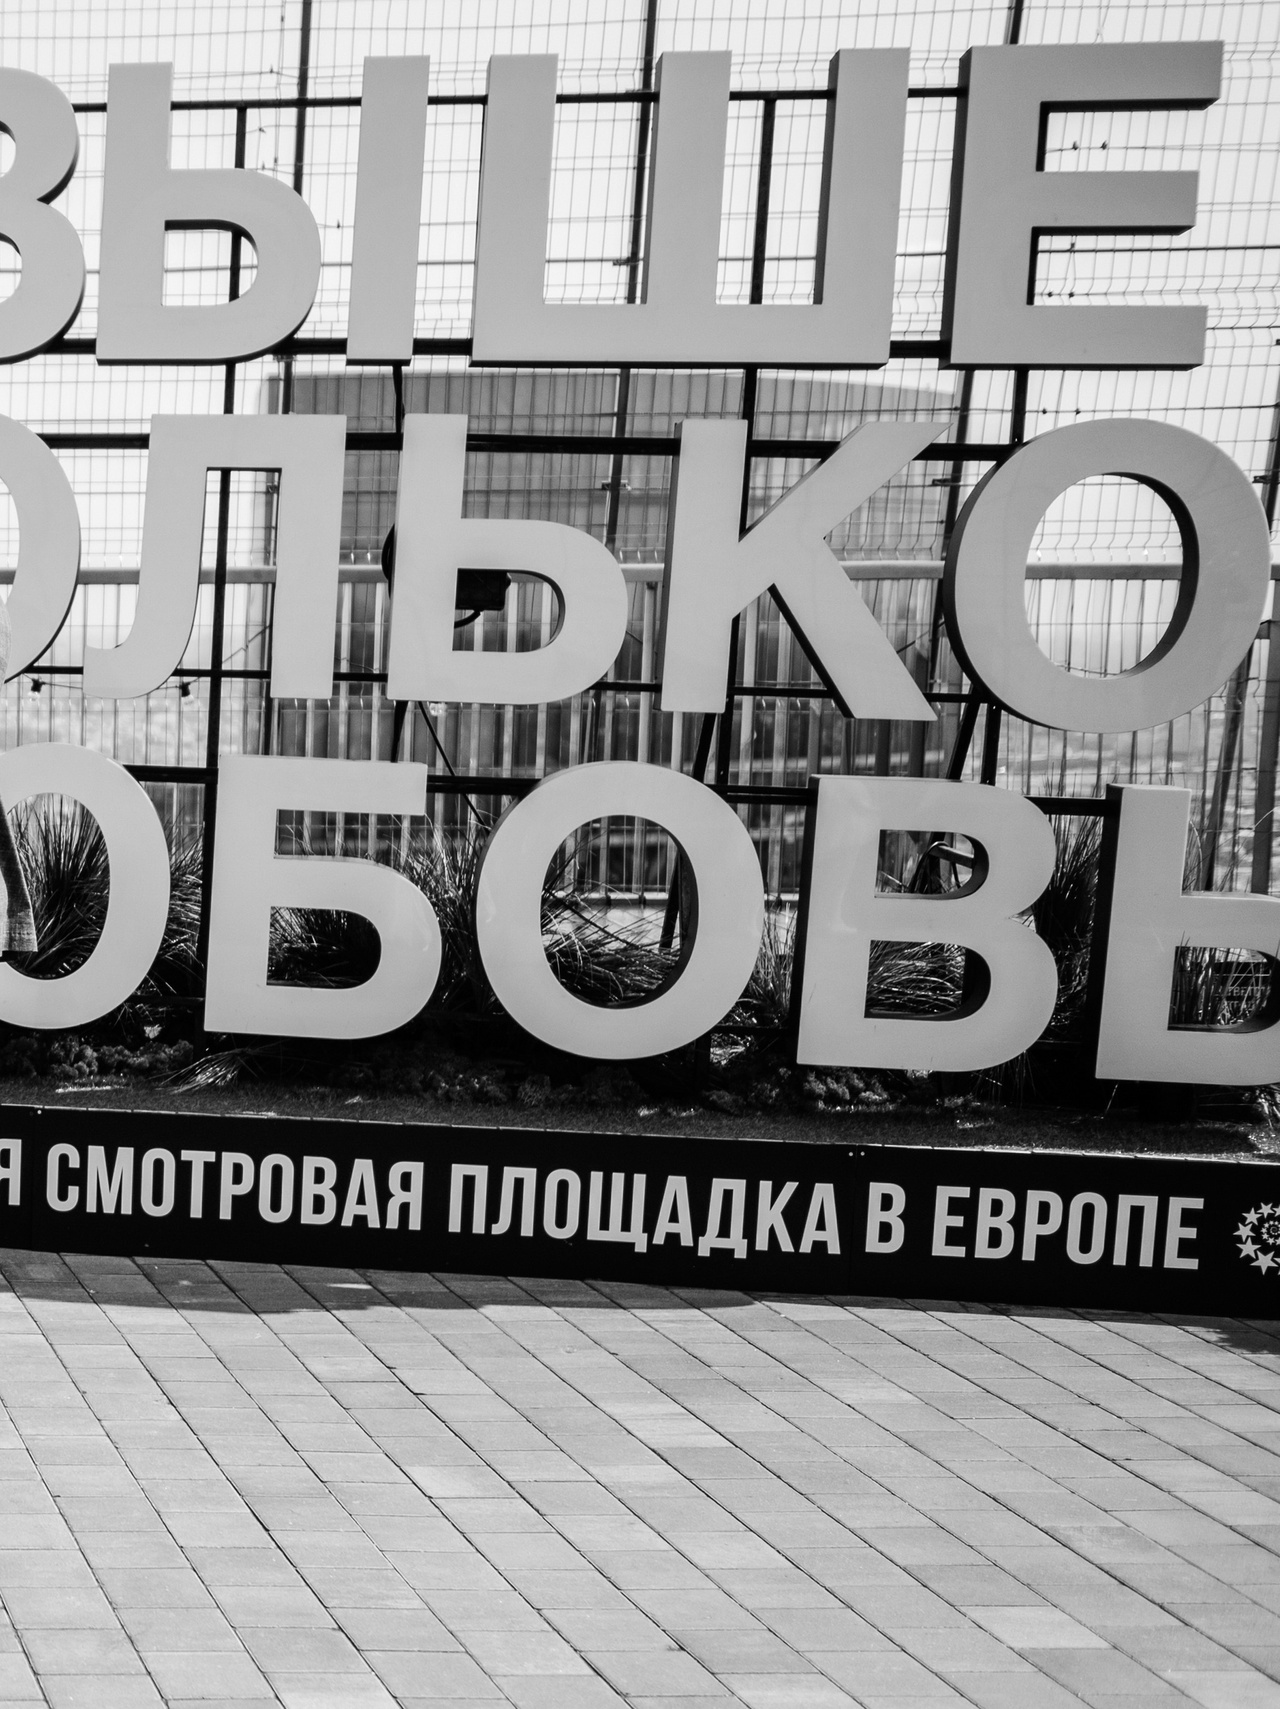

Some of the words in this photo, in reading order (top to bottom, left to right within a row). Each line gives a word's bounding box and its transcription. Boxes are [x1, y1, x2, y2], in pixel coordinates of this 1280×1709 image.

[46, 1142, 425, 1231] СМОТРОВАЯ
[448, 1163, 841, 1259] ПЛОЩАДКА
[864, 1181, 906, 1254] В
[931, 1185, 1205, 1270] ЕВРОПЕ
